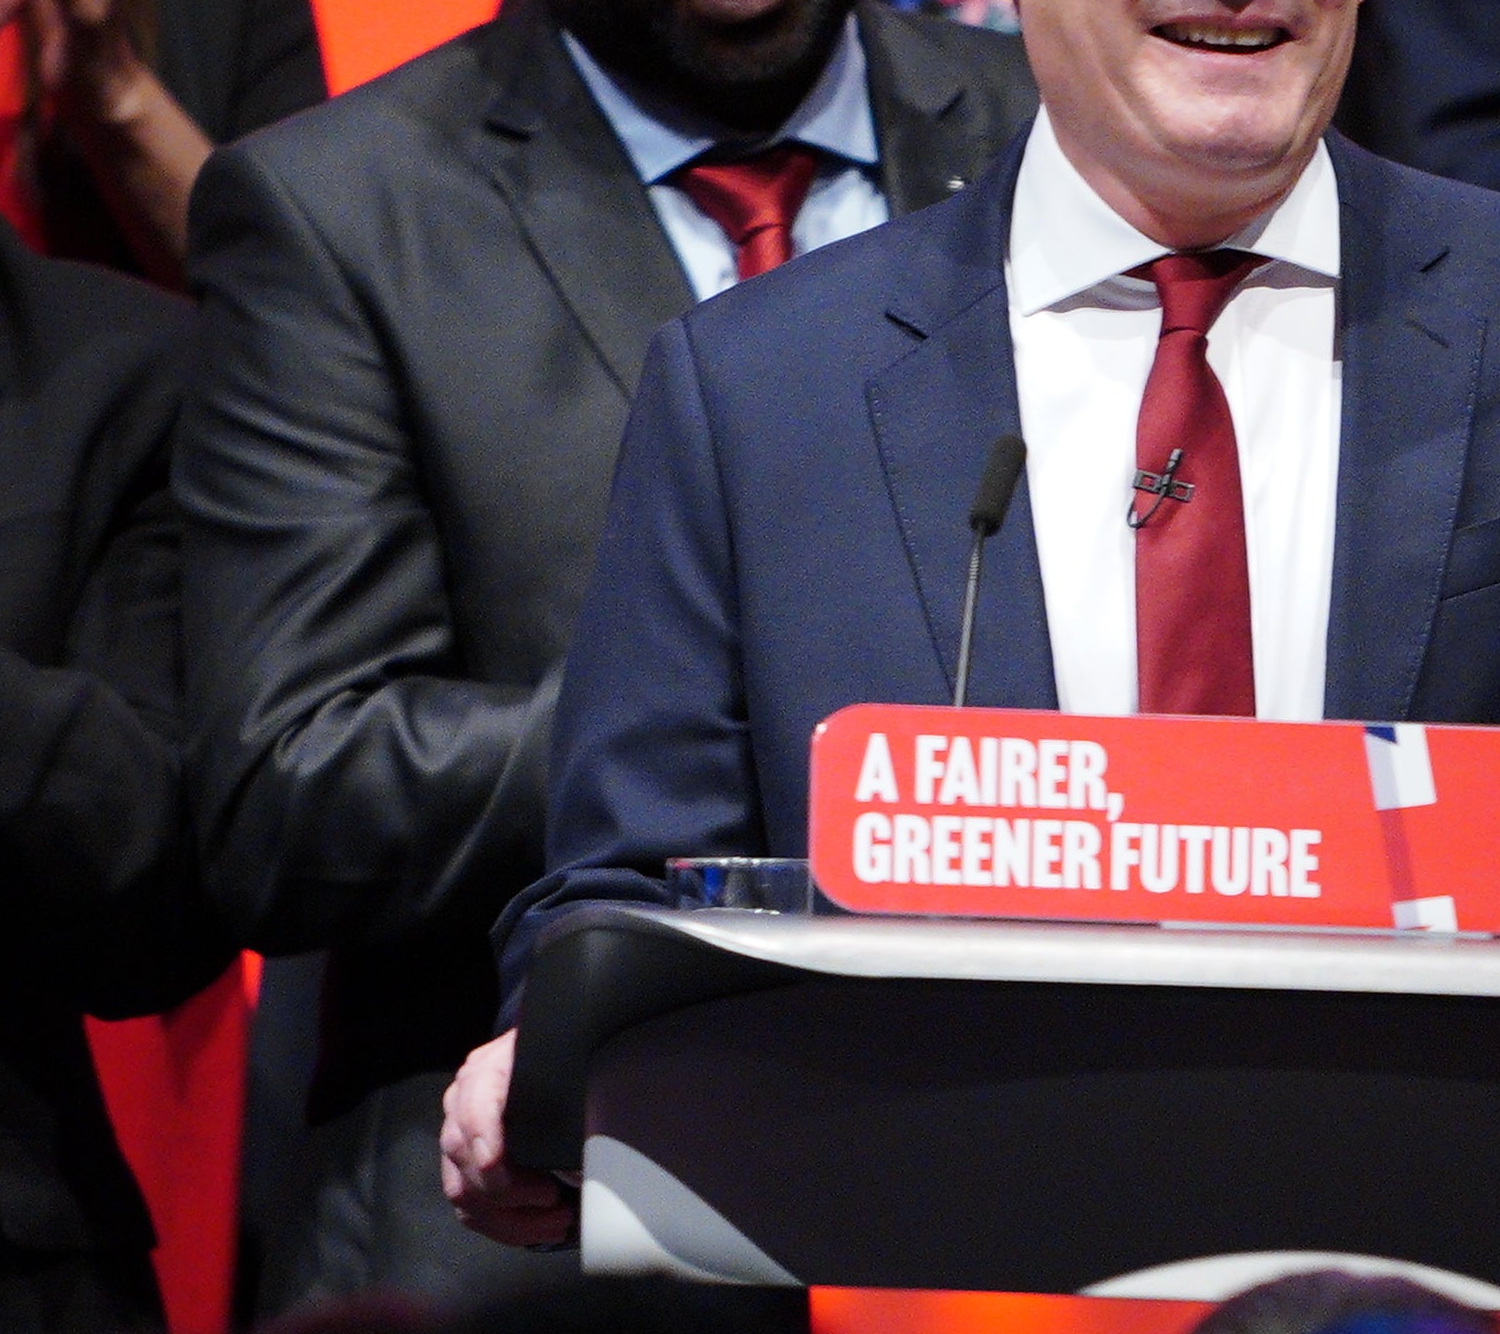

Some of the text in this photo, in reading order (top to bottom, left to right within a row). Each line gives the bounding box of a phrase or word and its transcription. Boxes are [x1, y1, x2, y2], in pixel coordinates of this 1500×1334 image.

[854, 733, 1123, 822] A FAIRER,
[853, 812, 1321, 898] GREENER FUTURE
